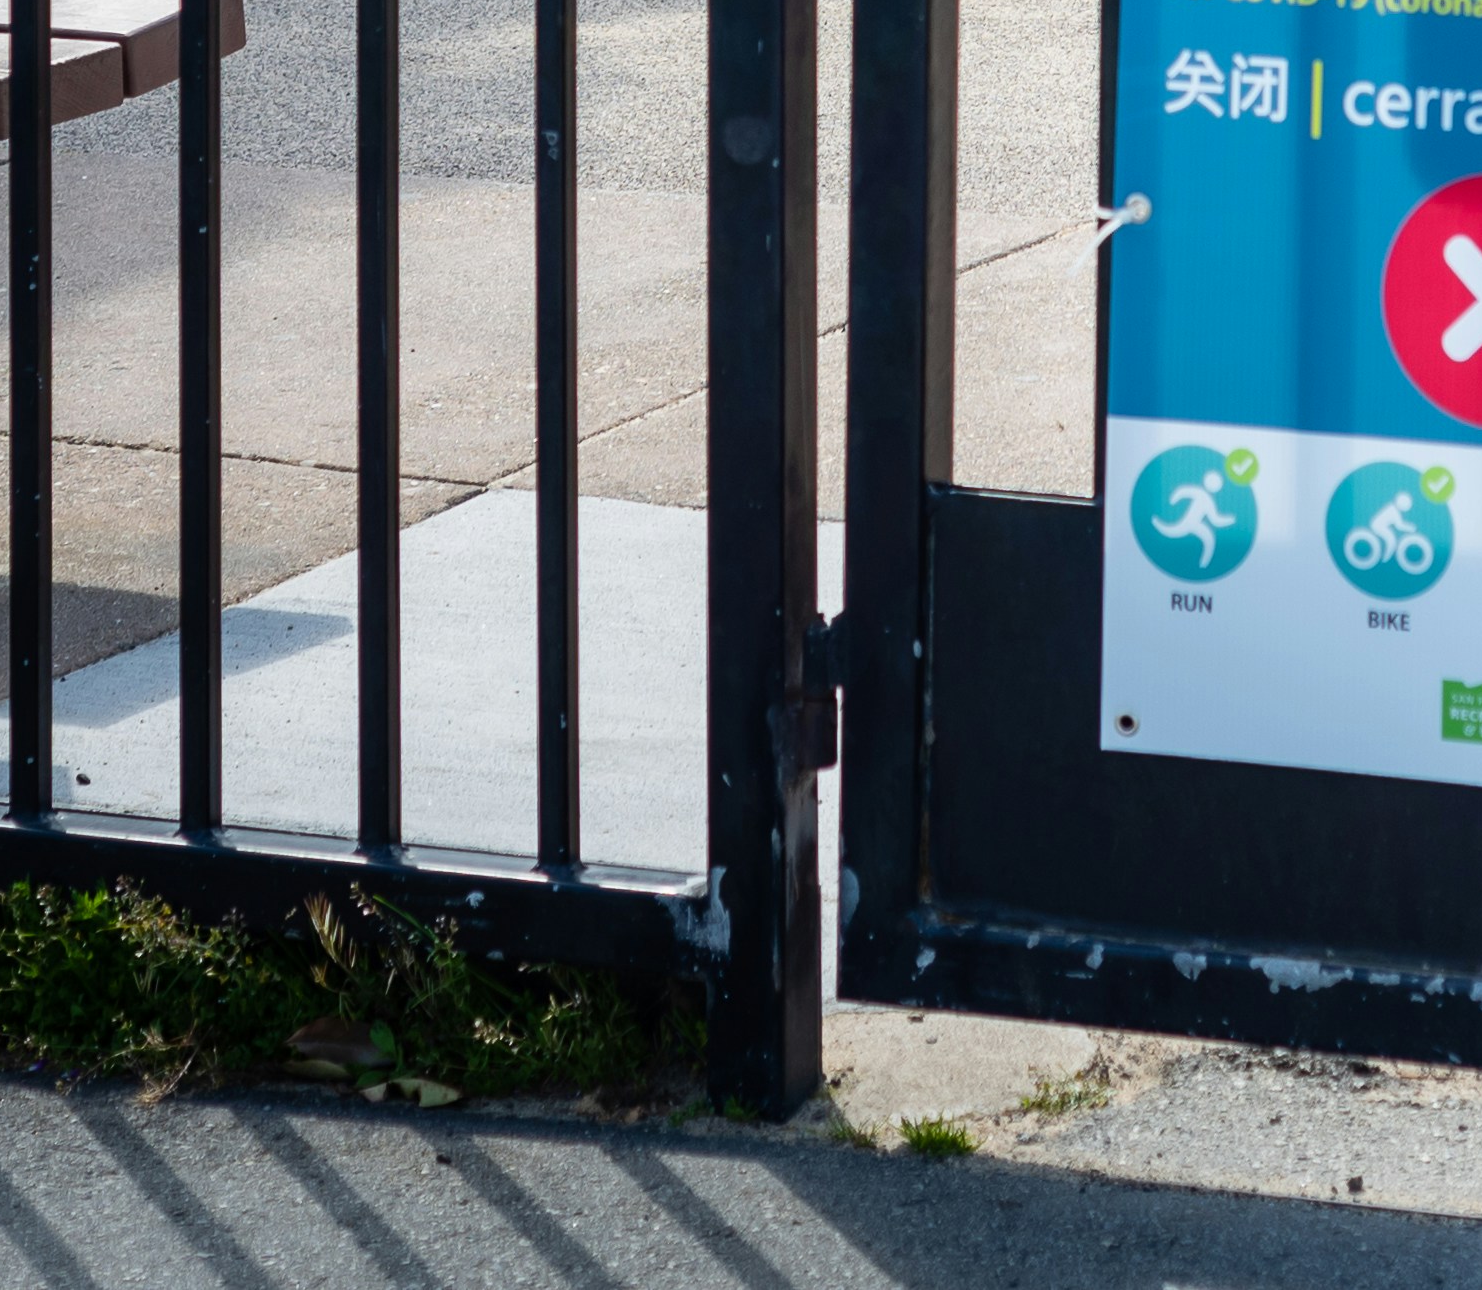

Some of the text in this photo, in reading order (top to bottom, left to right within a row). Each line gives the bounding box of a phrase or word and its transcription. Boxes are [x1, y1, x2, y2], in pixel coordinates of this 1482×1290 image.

[1164, 48, 1288, 123] 关闭
[1170, 592, 1213, 616] RUN
[1367, 609, 1411, 634] BIKE
[1451, 693, 1475, 706] SAN
